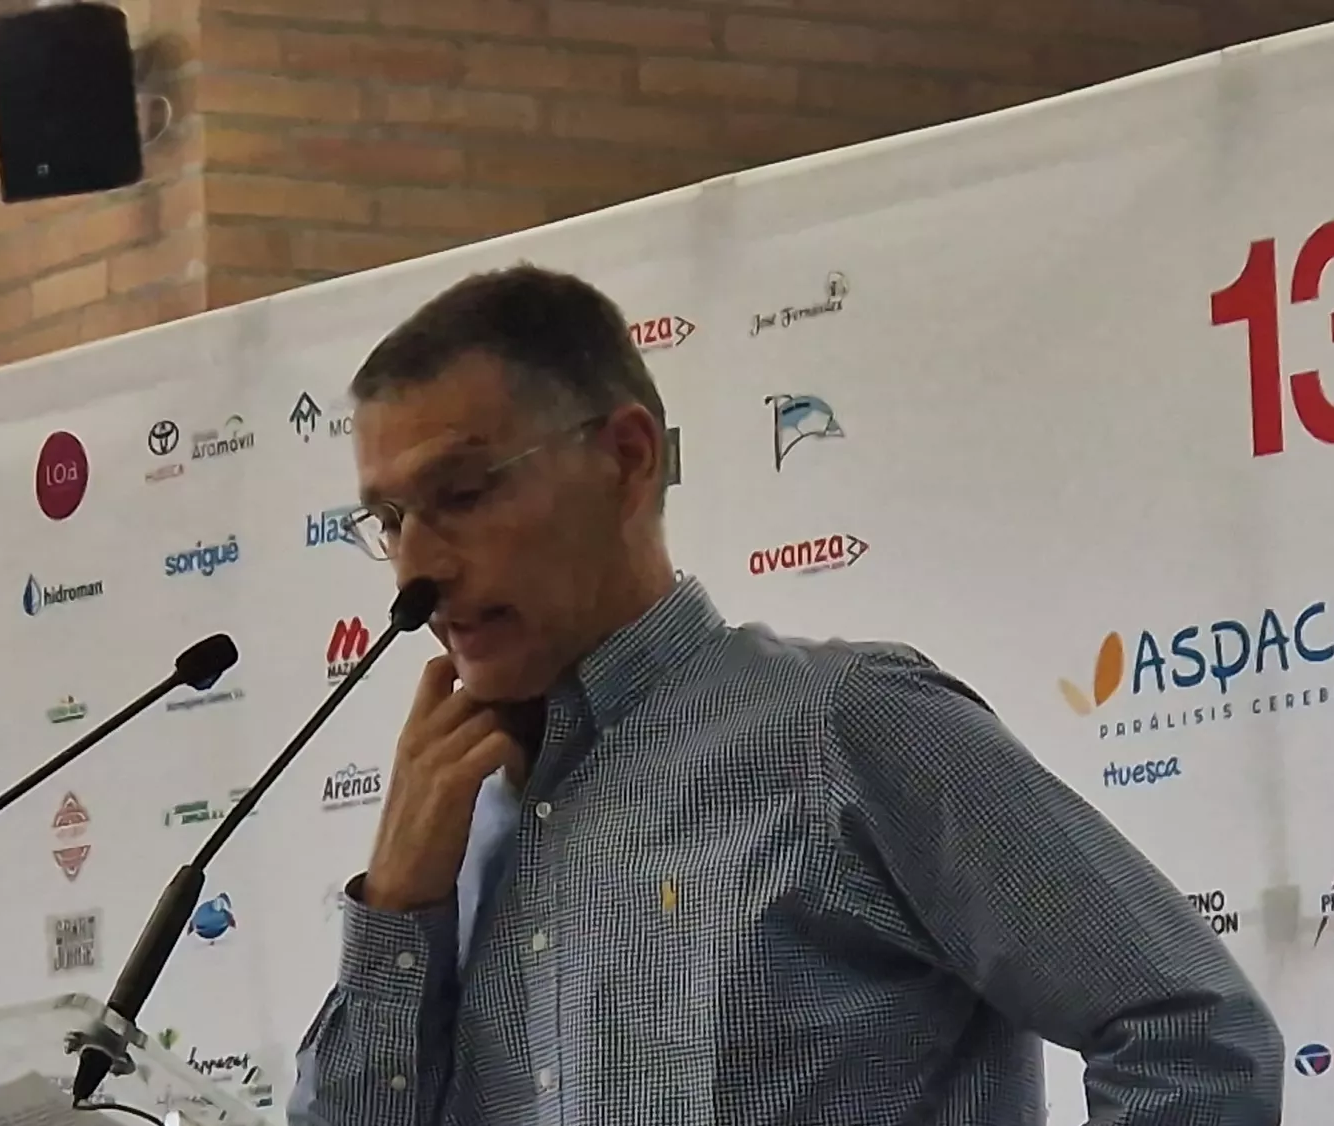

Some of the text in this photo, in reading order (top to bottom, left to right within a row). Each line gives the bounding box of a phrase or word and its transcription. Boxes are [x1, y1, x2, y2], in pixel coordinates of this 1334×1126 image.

[630, 316, 673, 346] nza
[749, 534, 845, 576] avanza
[322, 771, 383, 802] Arenas
[1102, 754, 1182, 789] Huesca
